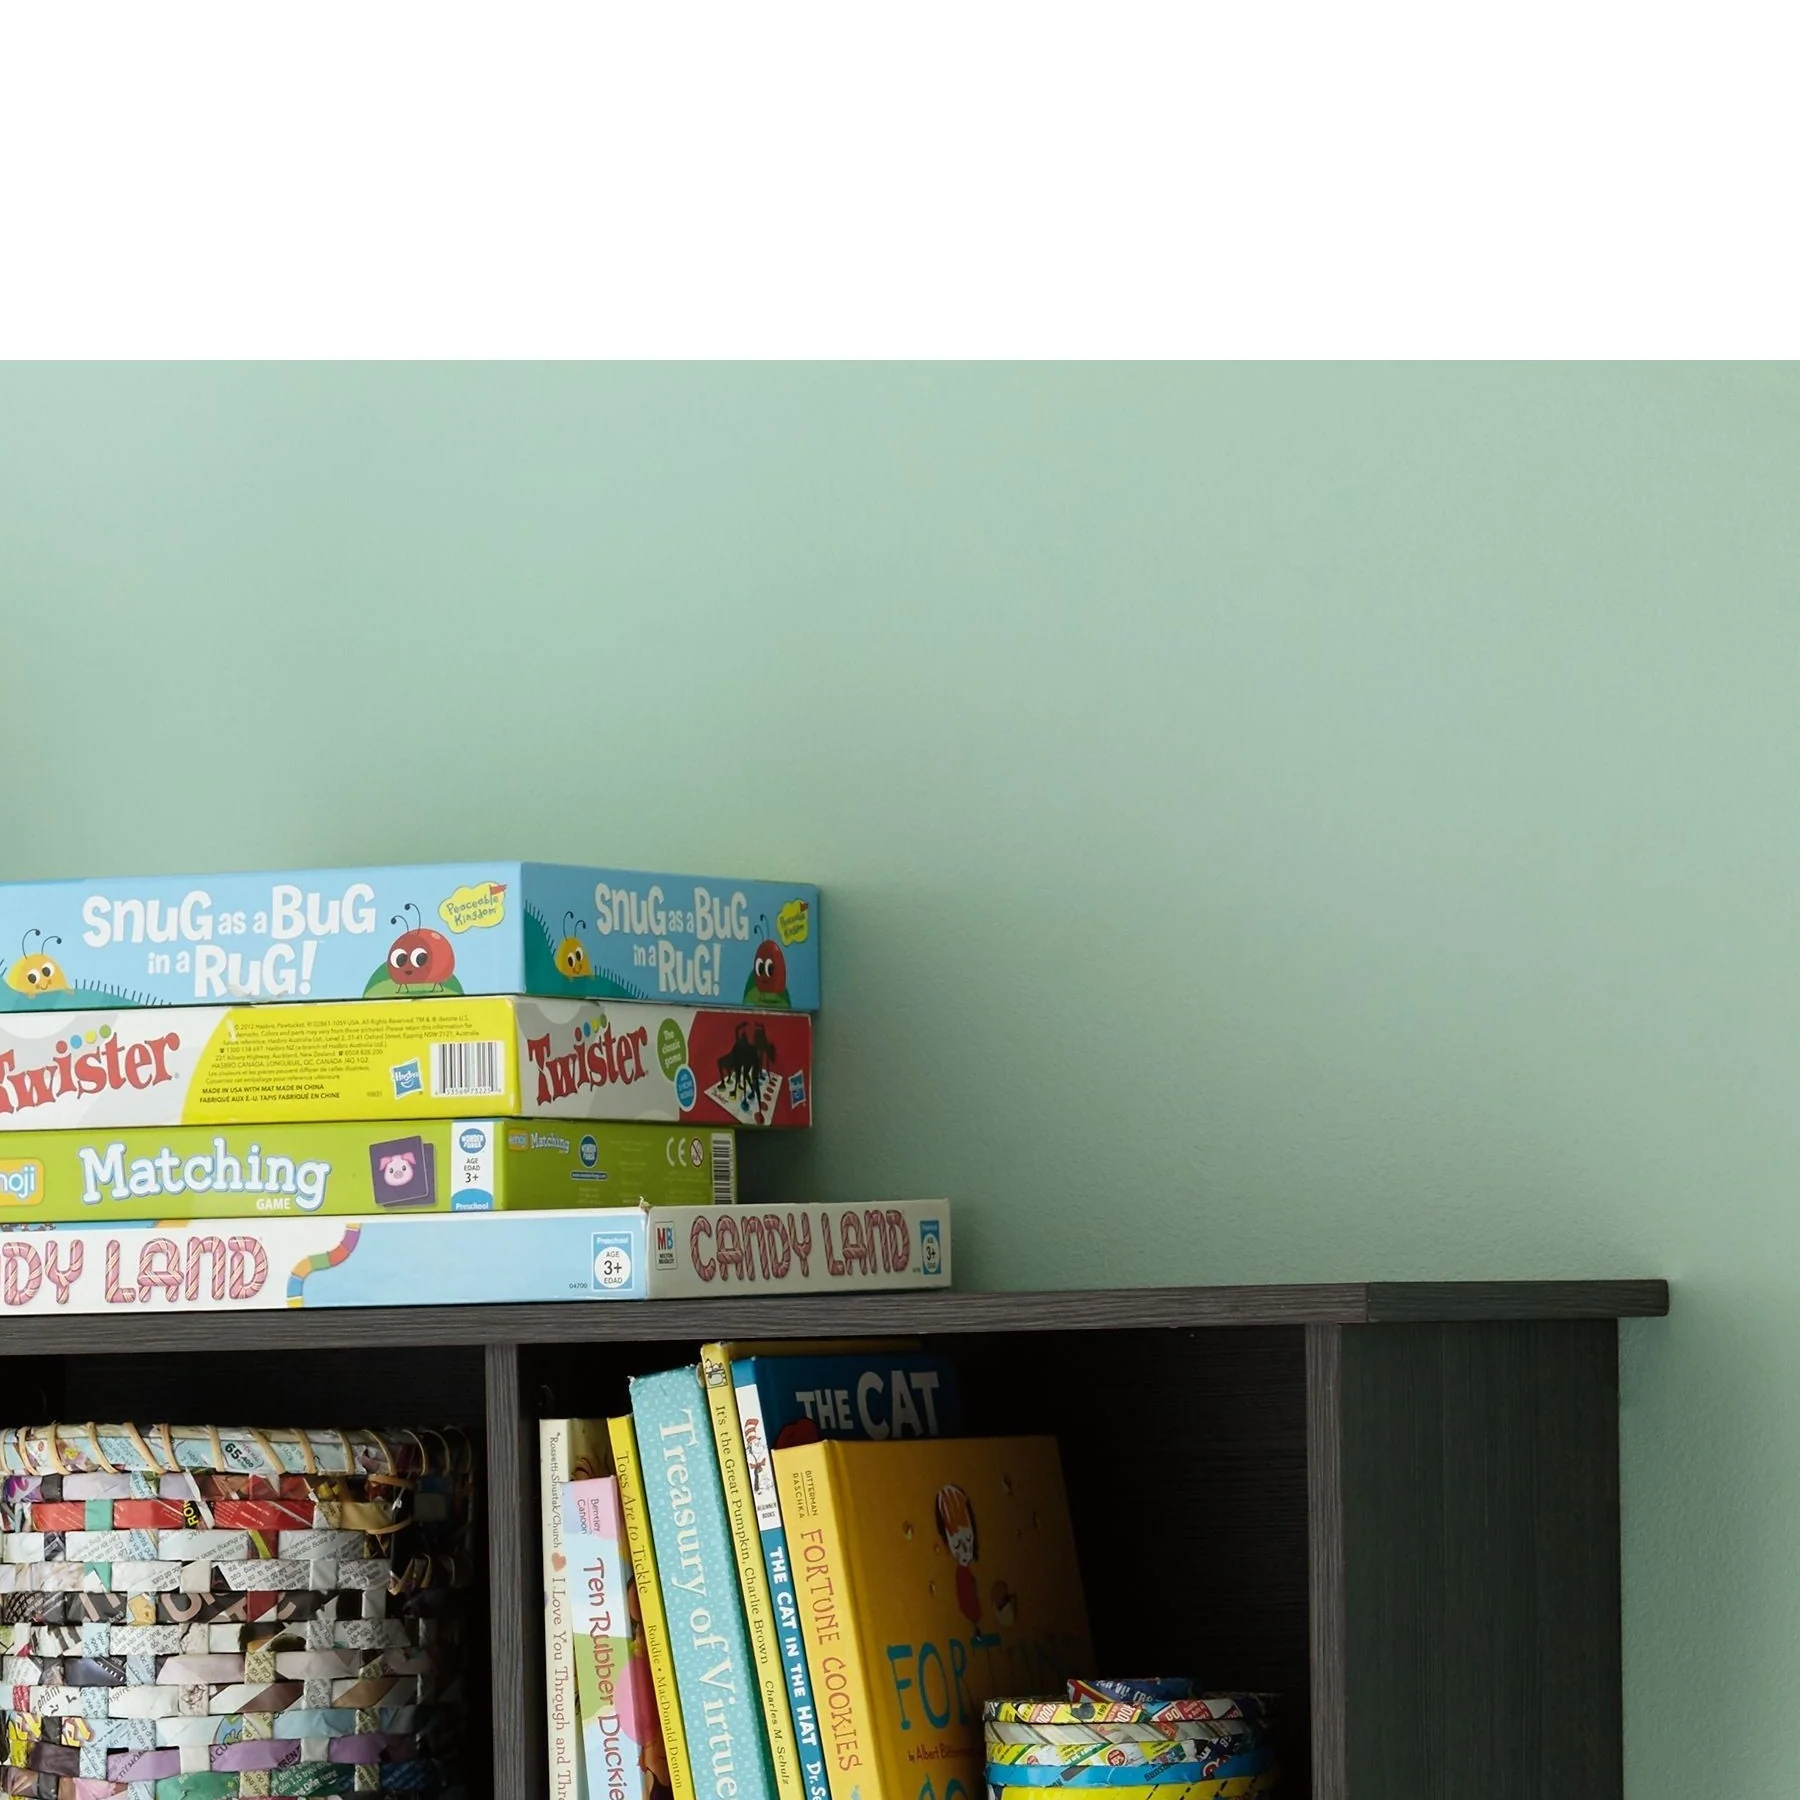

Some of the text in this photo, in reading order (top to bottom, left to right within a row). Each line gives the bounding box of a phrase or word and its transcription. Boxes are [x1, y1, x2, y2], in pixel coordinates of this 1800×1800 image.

[217, 910, 246, 936] as
[253, 909, 267, 934] a
[447, 893, 499, 917] Peaceable
[454, 906, 498, 927] Kingdom
[668, 911, 684, 934] as
[686, 912, 694, 934] a
[147, 950, 170, 975] in
[175, 951, 190, 974] a
[633, 944, 646, 967] in
[648, 946, 657, 967] a
[527, 1022, 648, 1107] Twister
[202, 1087, 221, 1095] MADE
[530, 1132, 570, 1154] Matching
[79, 1136, 332, 1212] Matching
[463, 1164, 481, 1172] EDAD
[465, 1172, 480, 1184] 3+
[256, 1198, 291, 1212] GAME
[455, 1201, 489, 1211] Preschool
[605, 1250, 620, 1258] AGE
[690, 1209, 911, 1282] CANDY LAND
[105, 1236, 269, 1304] LAND
[603, 1260, 623, 1276] 3+
[603, 1276, 624, 1285] EDAD
[715, 1405, 726, 1425] It's
[795, 1369, 940, 1440] THE CAT
[720, 1431, 731, 1455] the
[724, 1459, 740, 1495] Great
[804, 1470, 819, 1517] BITTERMAN
[792, 1472, 805, 1519] RASCHKA
[658, 1408, 707, 1598] Treasury
[689, 1608, 729, 1656] of
[731, 1498, 752, 1564] Pumpkin,
[583, 1557, 606, 1608] Ten
[769, 1545, 787, 1585] THE
[744, 1567, 760, 1615] Charlie
[616, 1450, 683, 1789] Toes Are to Tickle Roddie MacDonald Denton
[776, 1591, 797, 1630] CAT
[588, 1610, 615, 1706] Rubber
[753, 1620, 768, 1664] Brown
[783, 1637, 799, 1657] IN
[800, 1528, 863, 1772] FORTUNE COOKIES
[788, 1663, 806, 1698] THE
[765, 1680, 778, 1725] Charles
[773, 1728, 783, 1743] M.
[796, 1705, 817, 1747] HAT
[777, 1746, 790, 1785] Schulz
[806, 1760, 821, 1785] Dr.
